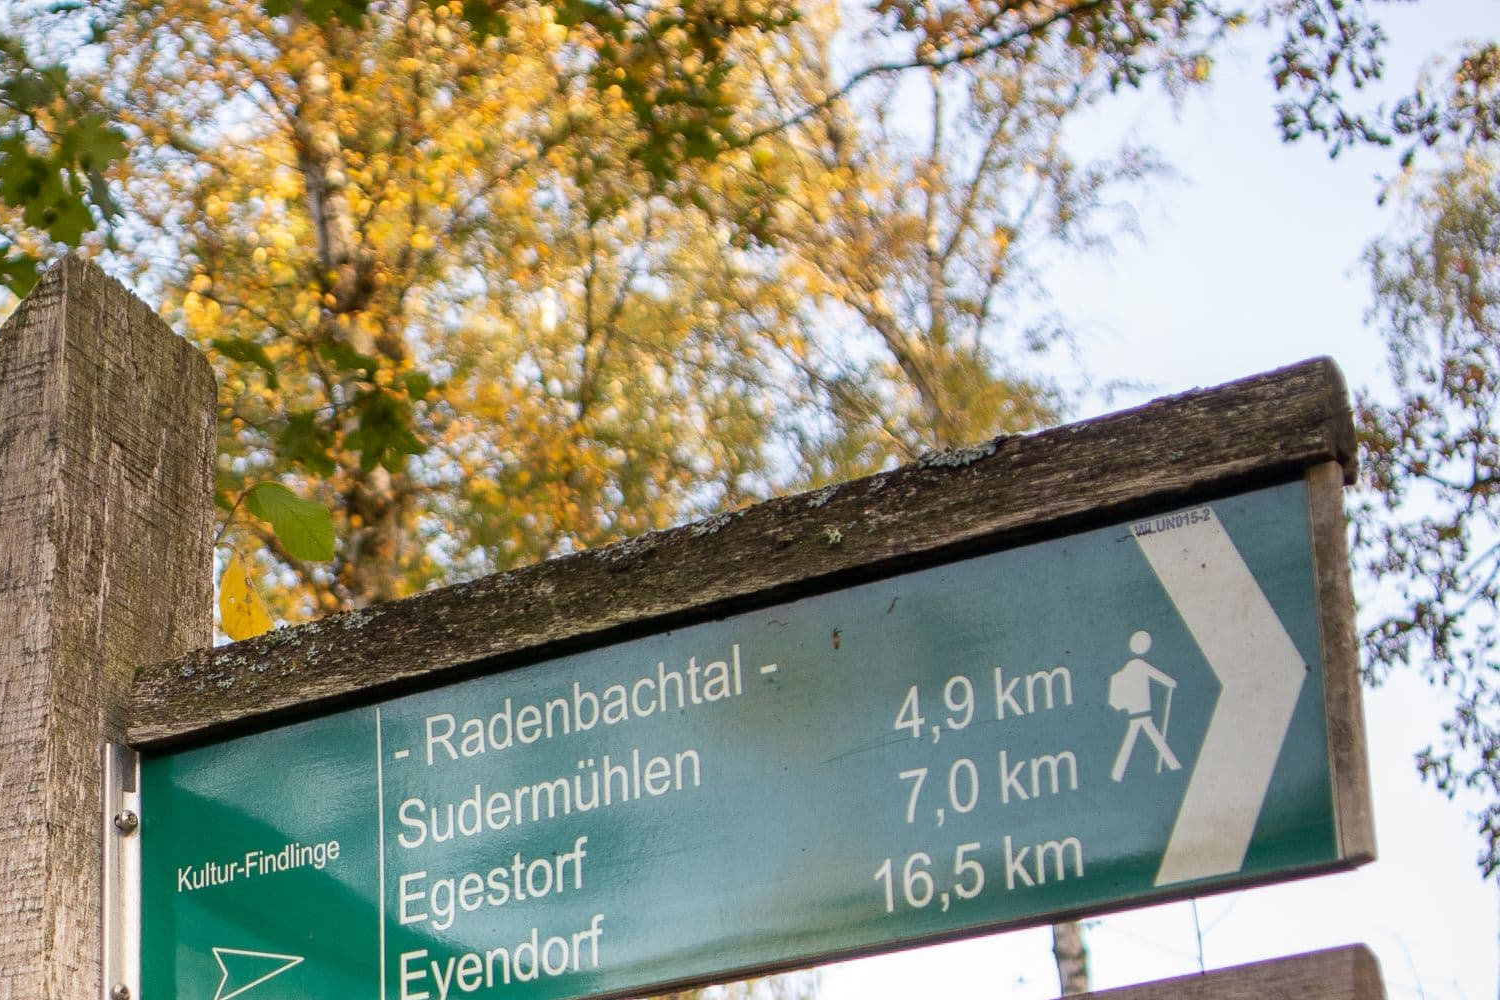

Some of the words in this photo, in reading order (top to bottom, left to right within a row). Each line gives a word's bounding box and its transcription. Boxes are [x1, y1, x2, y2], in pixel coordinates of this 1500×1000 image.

[1134, 508, 1211, 537] WLUN015-2
[425, 642, 743, 766] Radenbachtal
[894, 676, 975, 744] 4,9
[994, 665, 1073, 720] km
[397, 749, 702, 850] Sudermühlen
[898, 757, 980, 829] 7,0
[999, 749, 1079, 804] km
[177, 837, 341, 894] Kultur-Findlinge
[398, 836, 588, 931] Egestorf
[874, 841, 985, 913] 16,5
[1004, 834, 1084, 891] km
